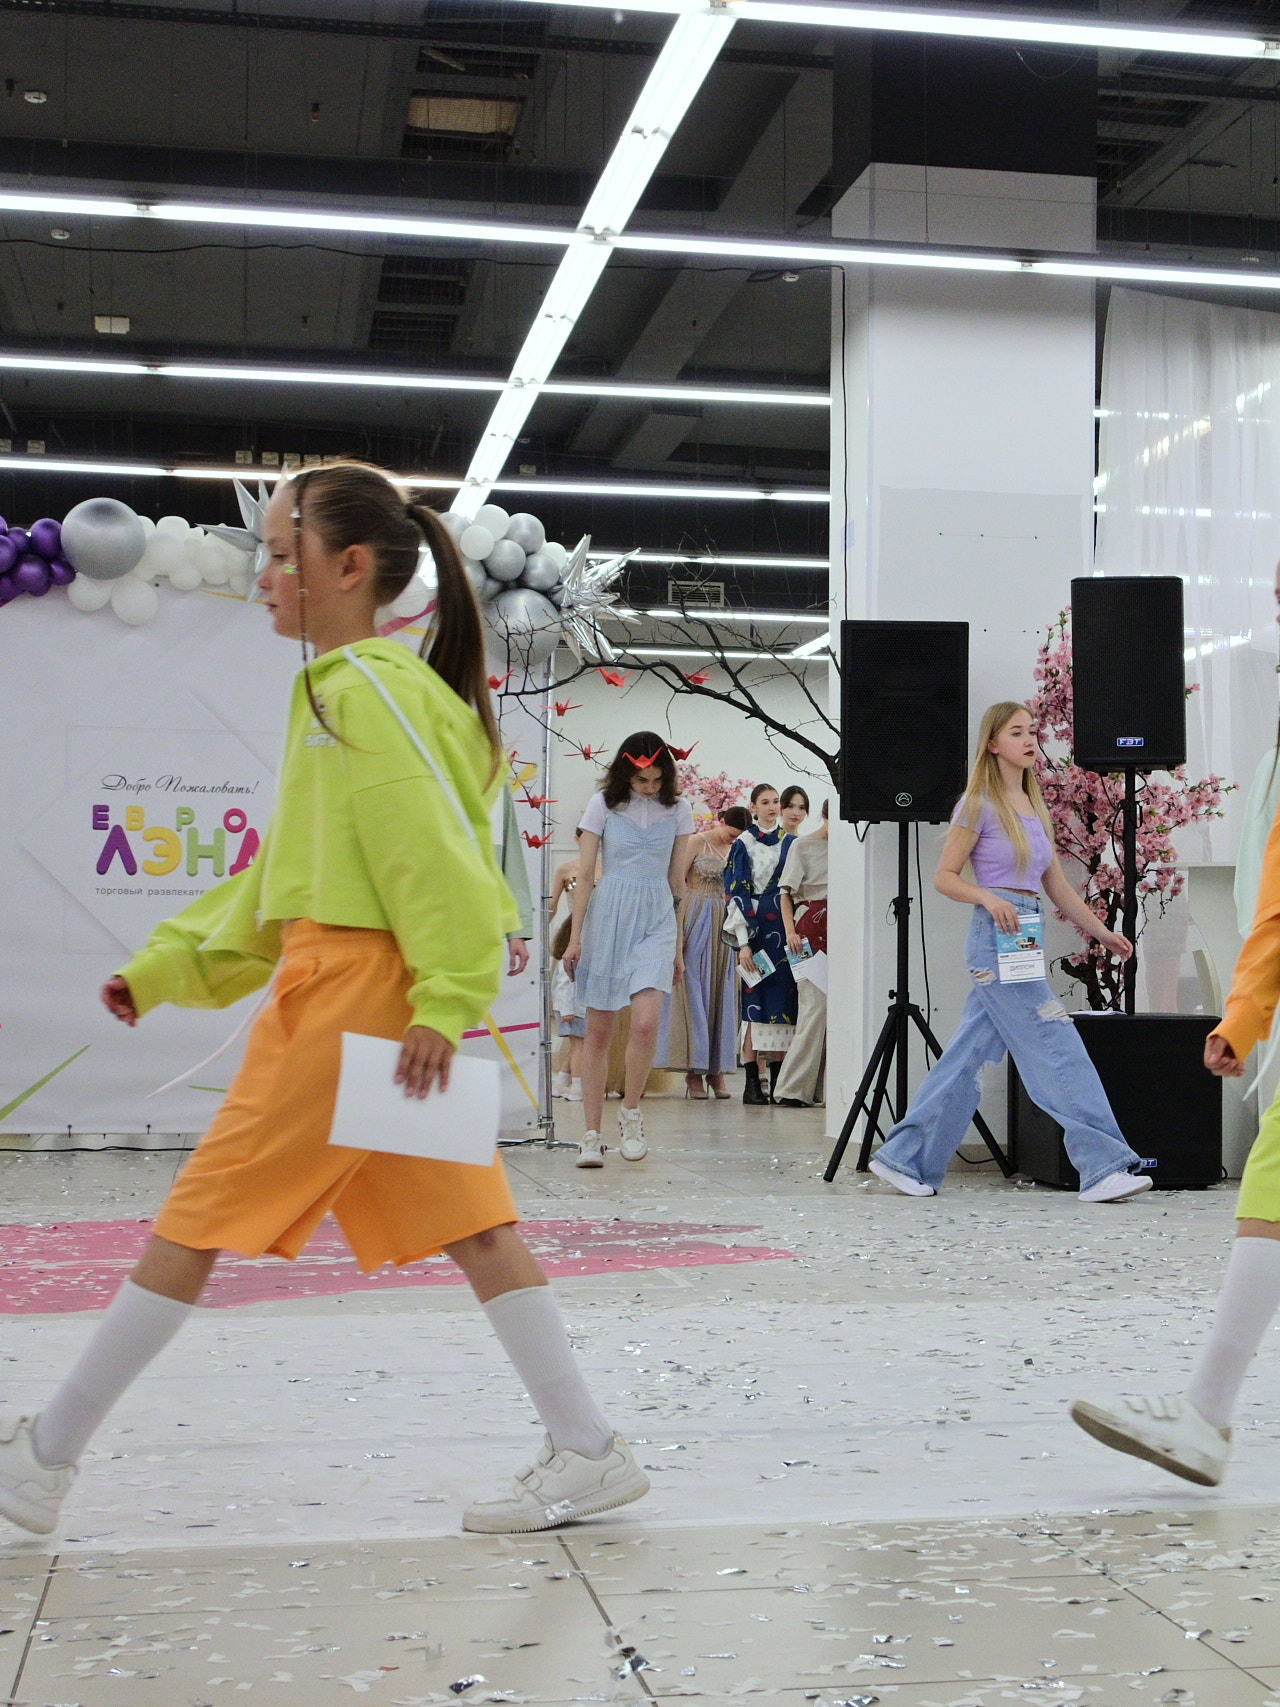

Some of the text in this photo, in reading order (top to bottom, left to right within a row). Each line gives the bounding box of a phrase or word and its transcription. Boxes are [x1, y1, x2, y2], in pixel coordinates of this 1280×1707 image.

[101, 774, 260, 795] Добро Пожаловать!
[95, 887, 206, 897] торговый развлекате
